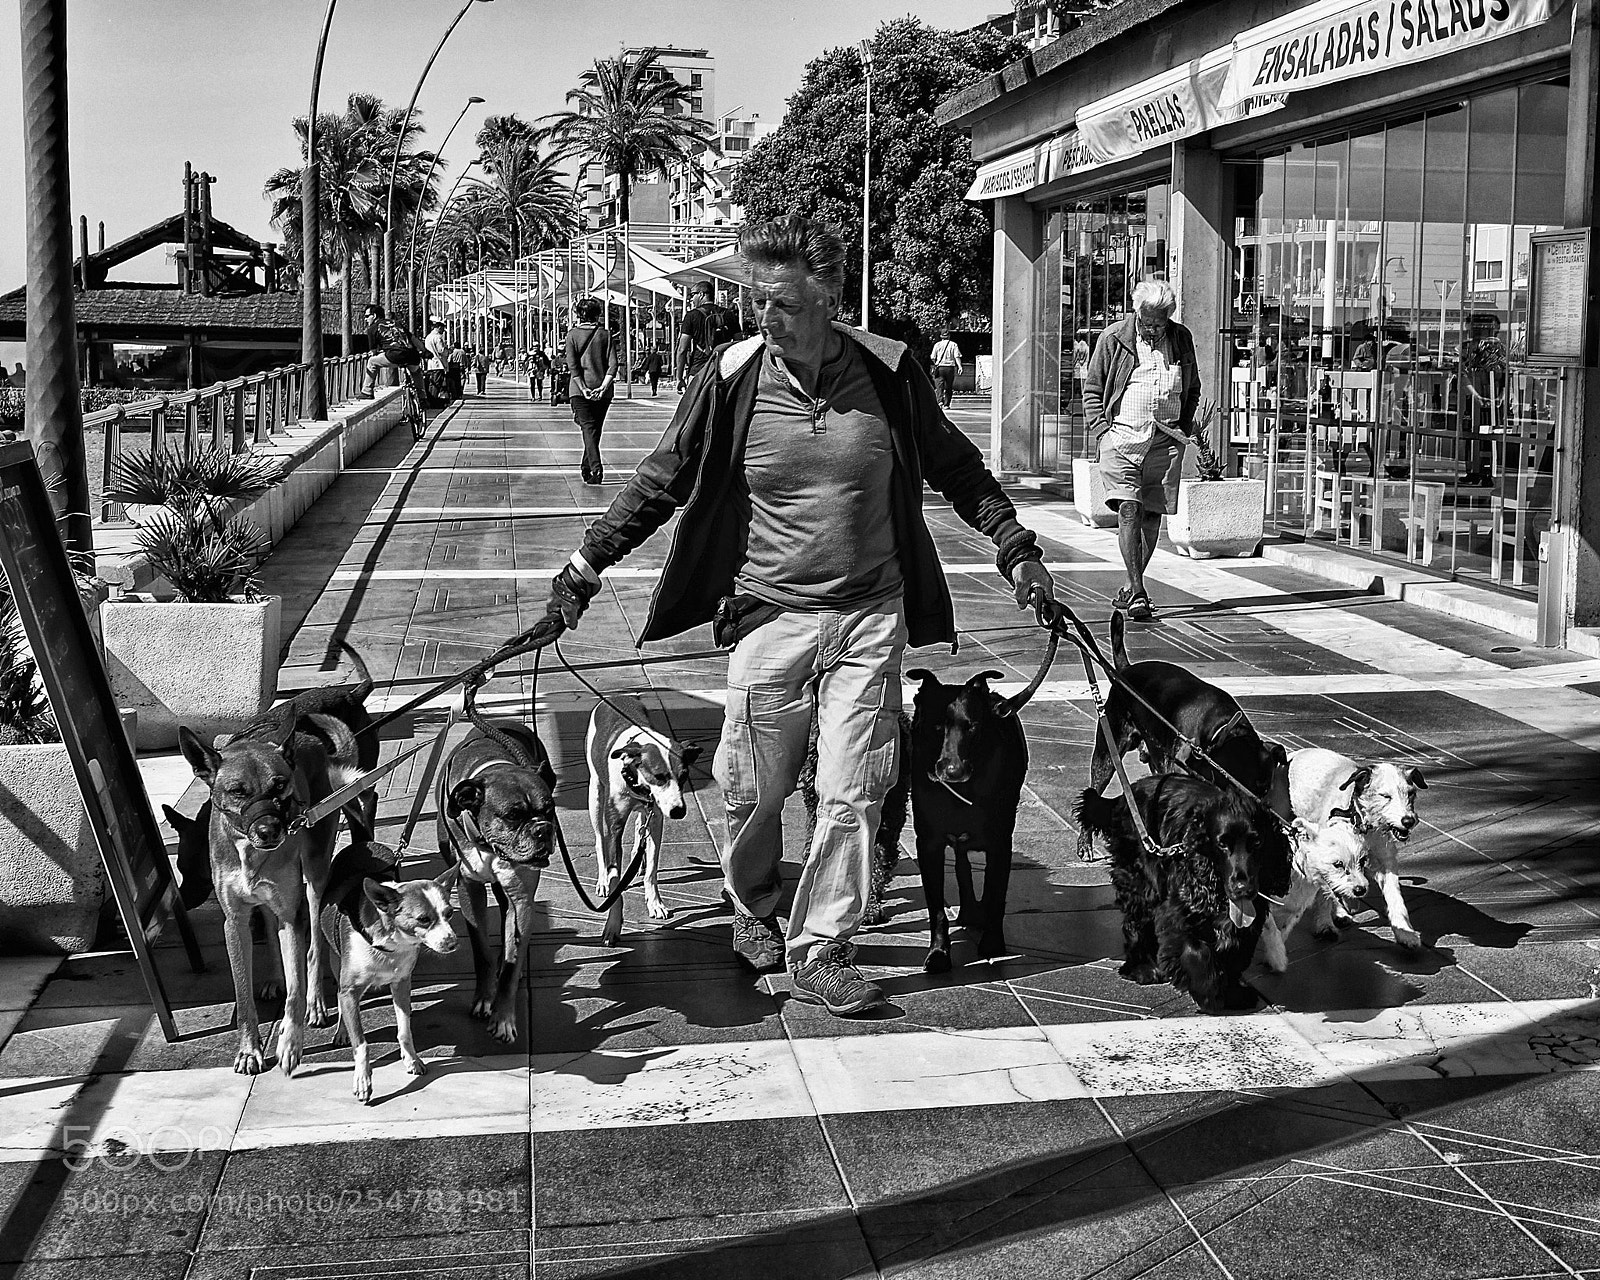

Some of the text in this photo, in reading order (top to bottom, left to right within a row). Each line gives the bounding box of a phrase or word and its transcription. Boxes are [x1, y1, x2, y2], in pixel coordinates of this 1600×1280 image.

[1252, 11, 1380, 87] ENSALADAS
[1129, 93, 1186, 142] PAELLAS
[1556, 254, 1585, 264] RESTAURANTE
